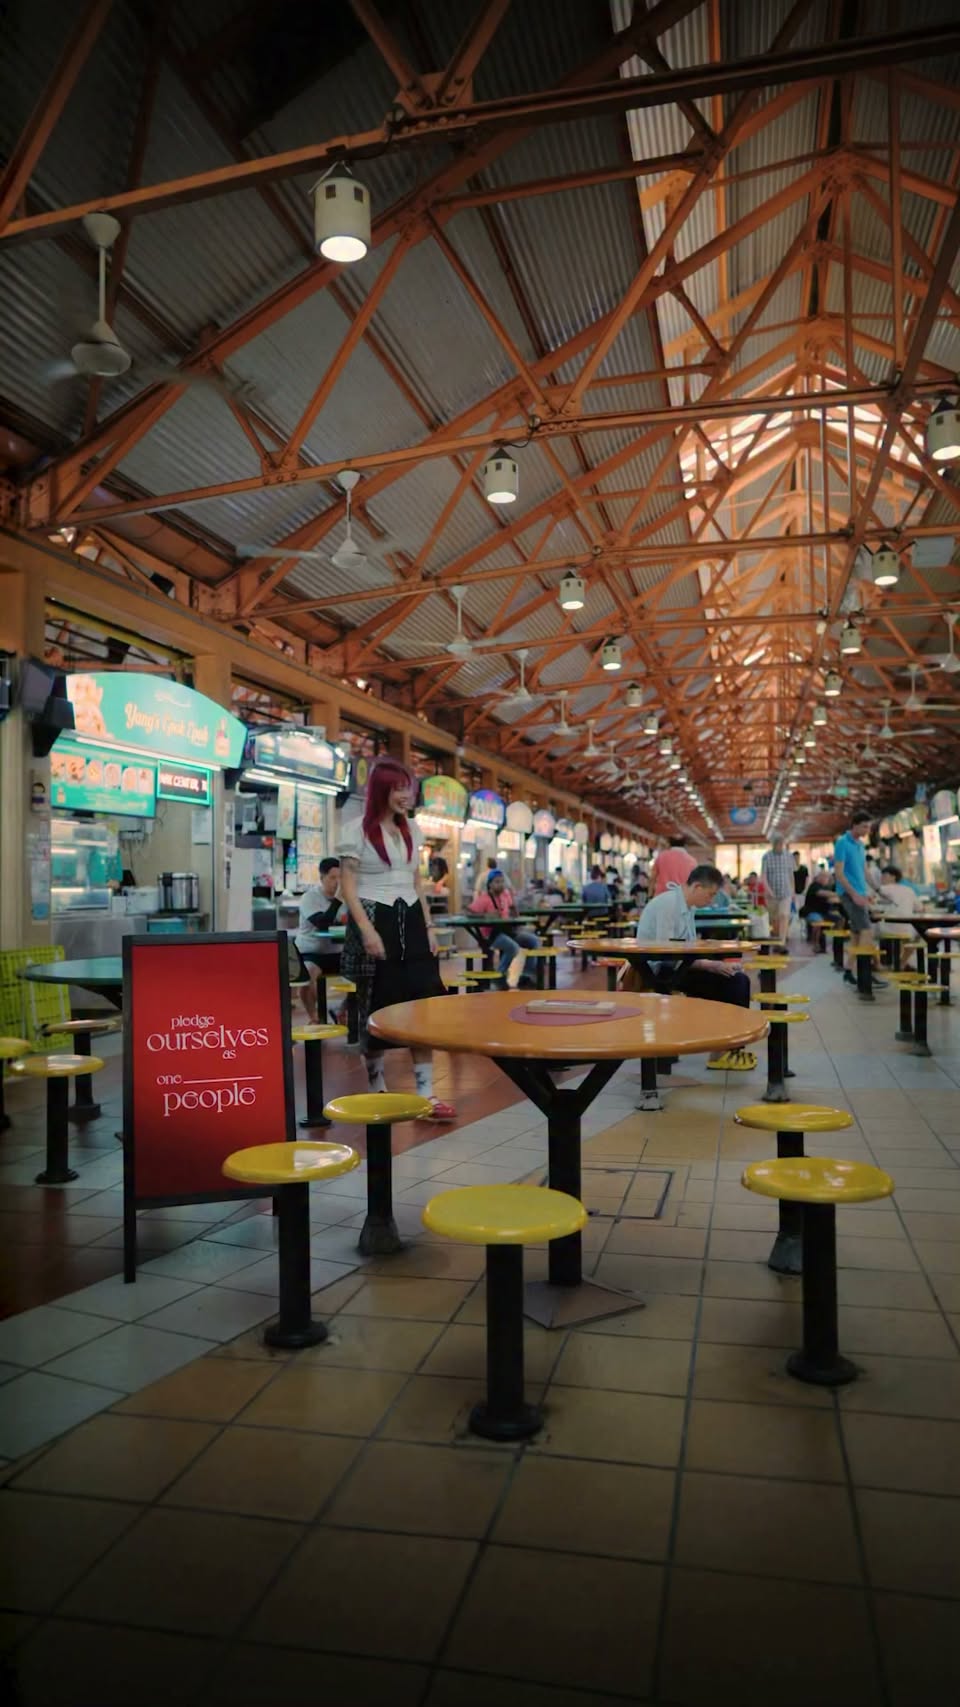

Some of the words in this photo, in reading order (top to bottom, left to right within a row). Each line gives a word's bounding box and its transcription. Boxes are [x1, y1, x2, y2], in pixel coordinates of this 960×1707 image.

[171, 1014, 215, 1030] pledge
[147, 1024, 269, 1052] ourselves
[222, 1049, 237, 1060] as
[156, 1074, 183, 1085] one
[163, 1082, 256, 1117] people
